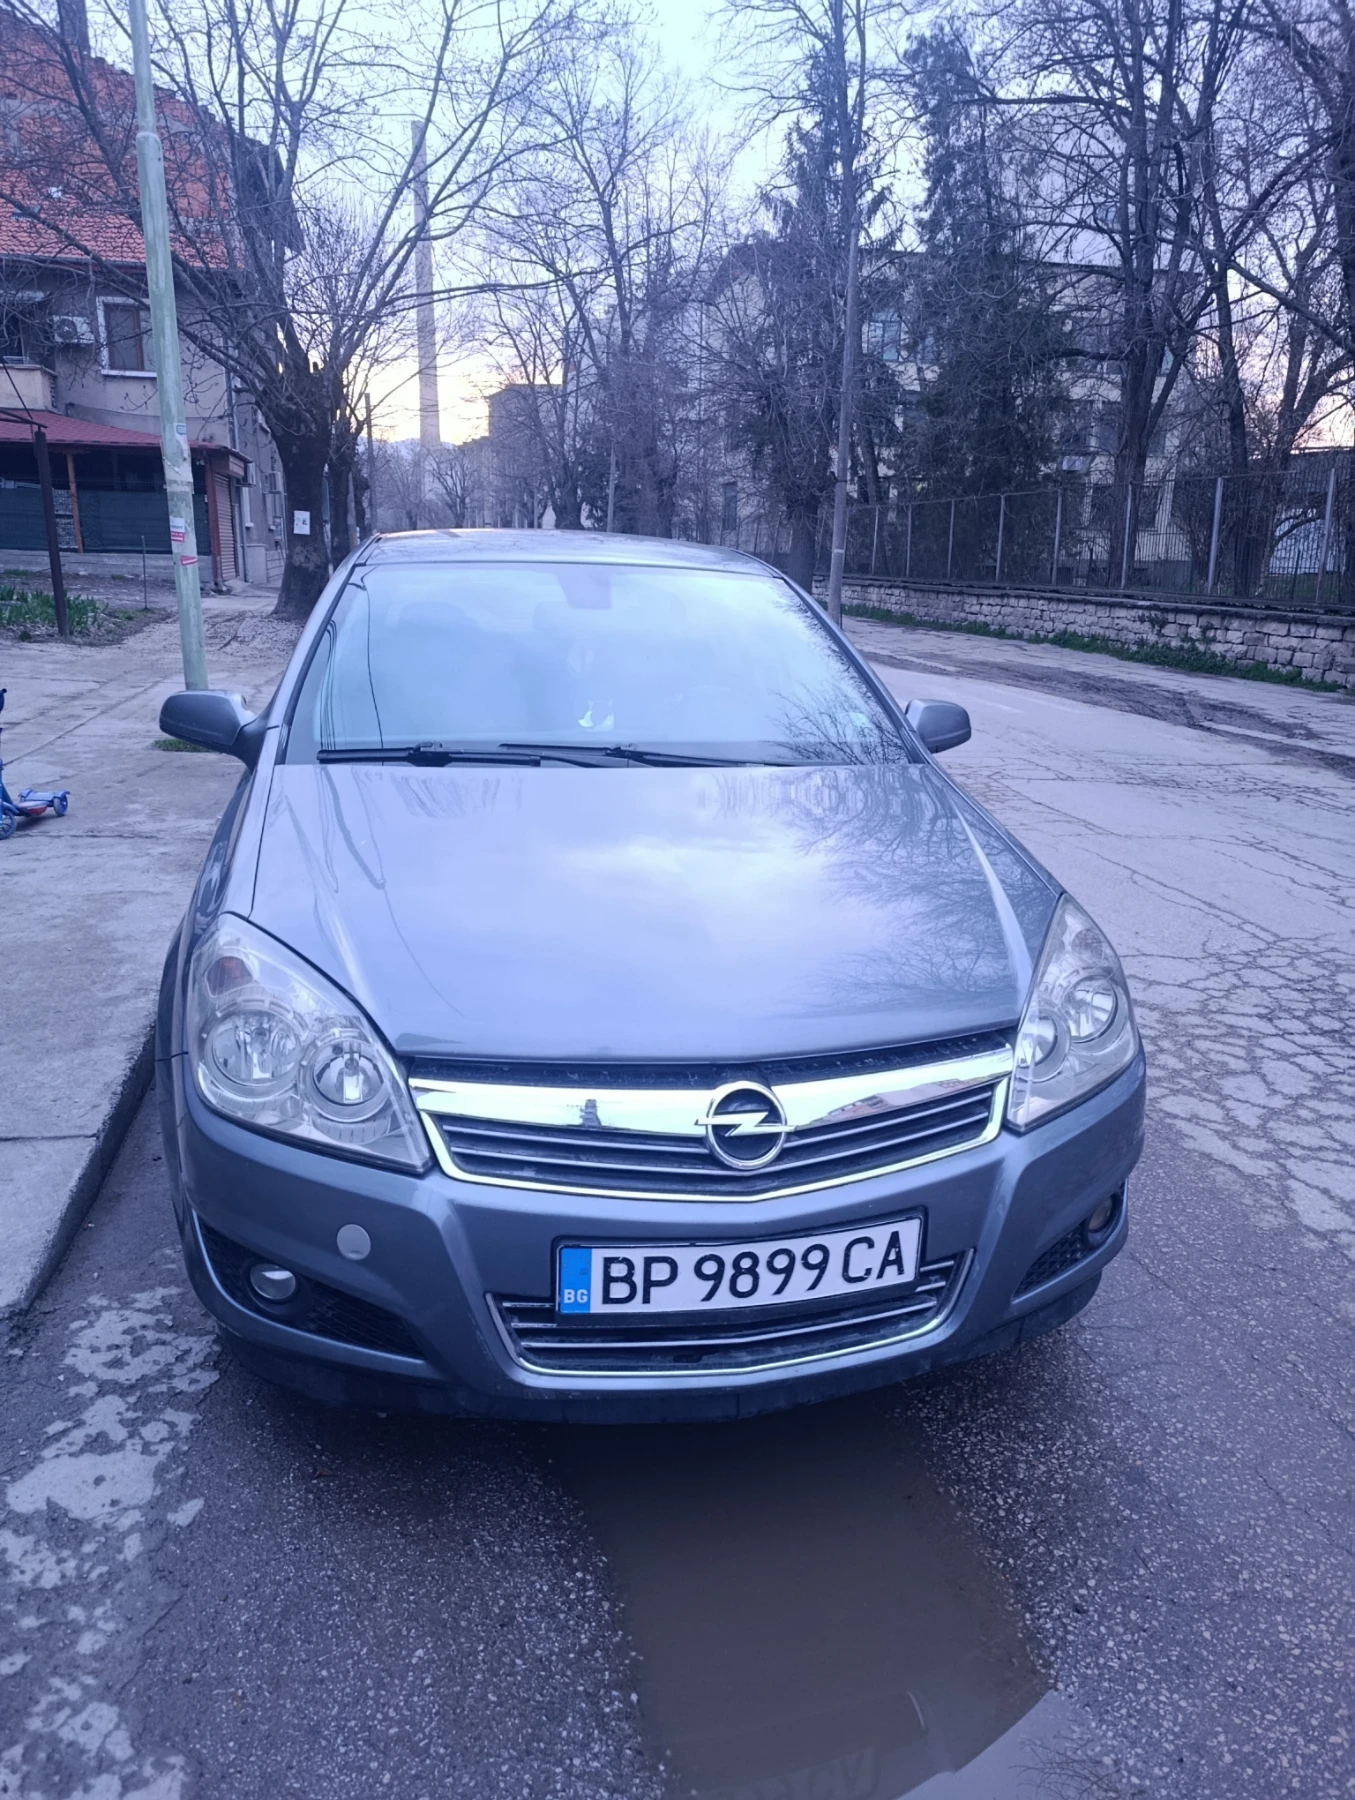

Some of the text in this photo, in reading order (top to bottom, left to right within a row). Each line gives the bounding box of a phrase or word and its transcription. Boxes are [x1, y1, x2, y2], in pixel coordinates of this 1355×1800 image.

[602, 1230, 905, 1305] BP 9899 CA
[563, 1288, 588, 1304] BG
